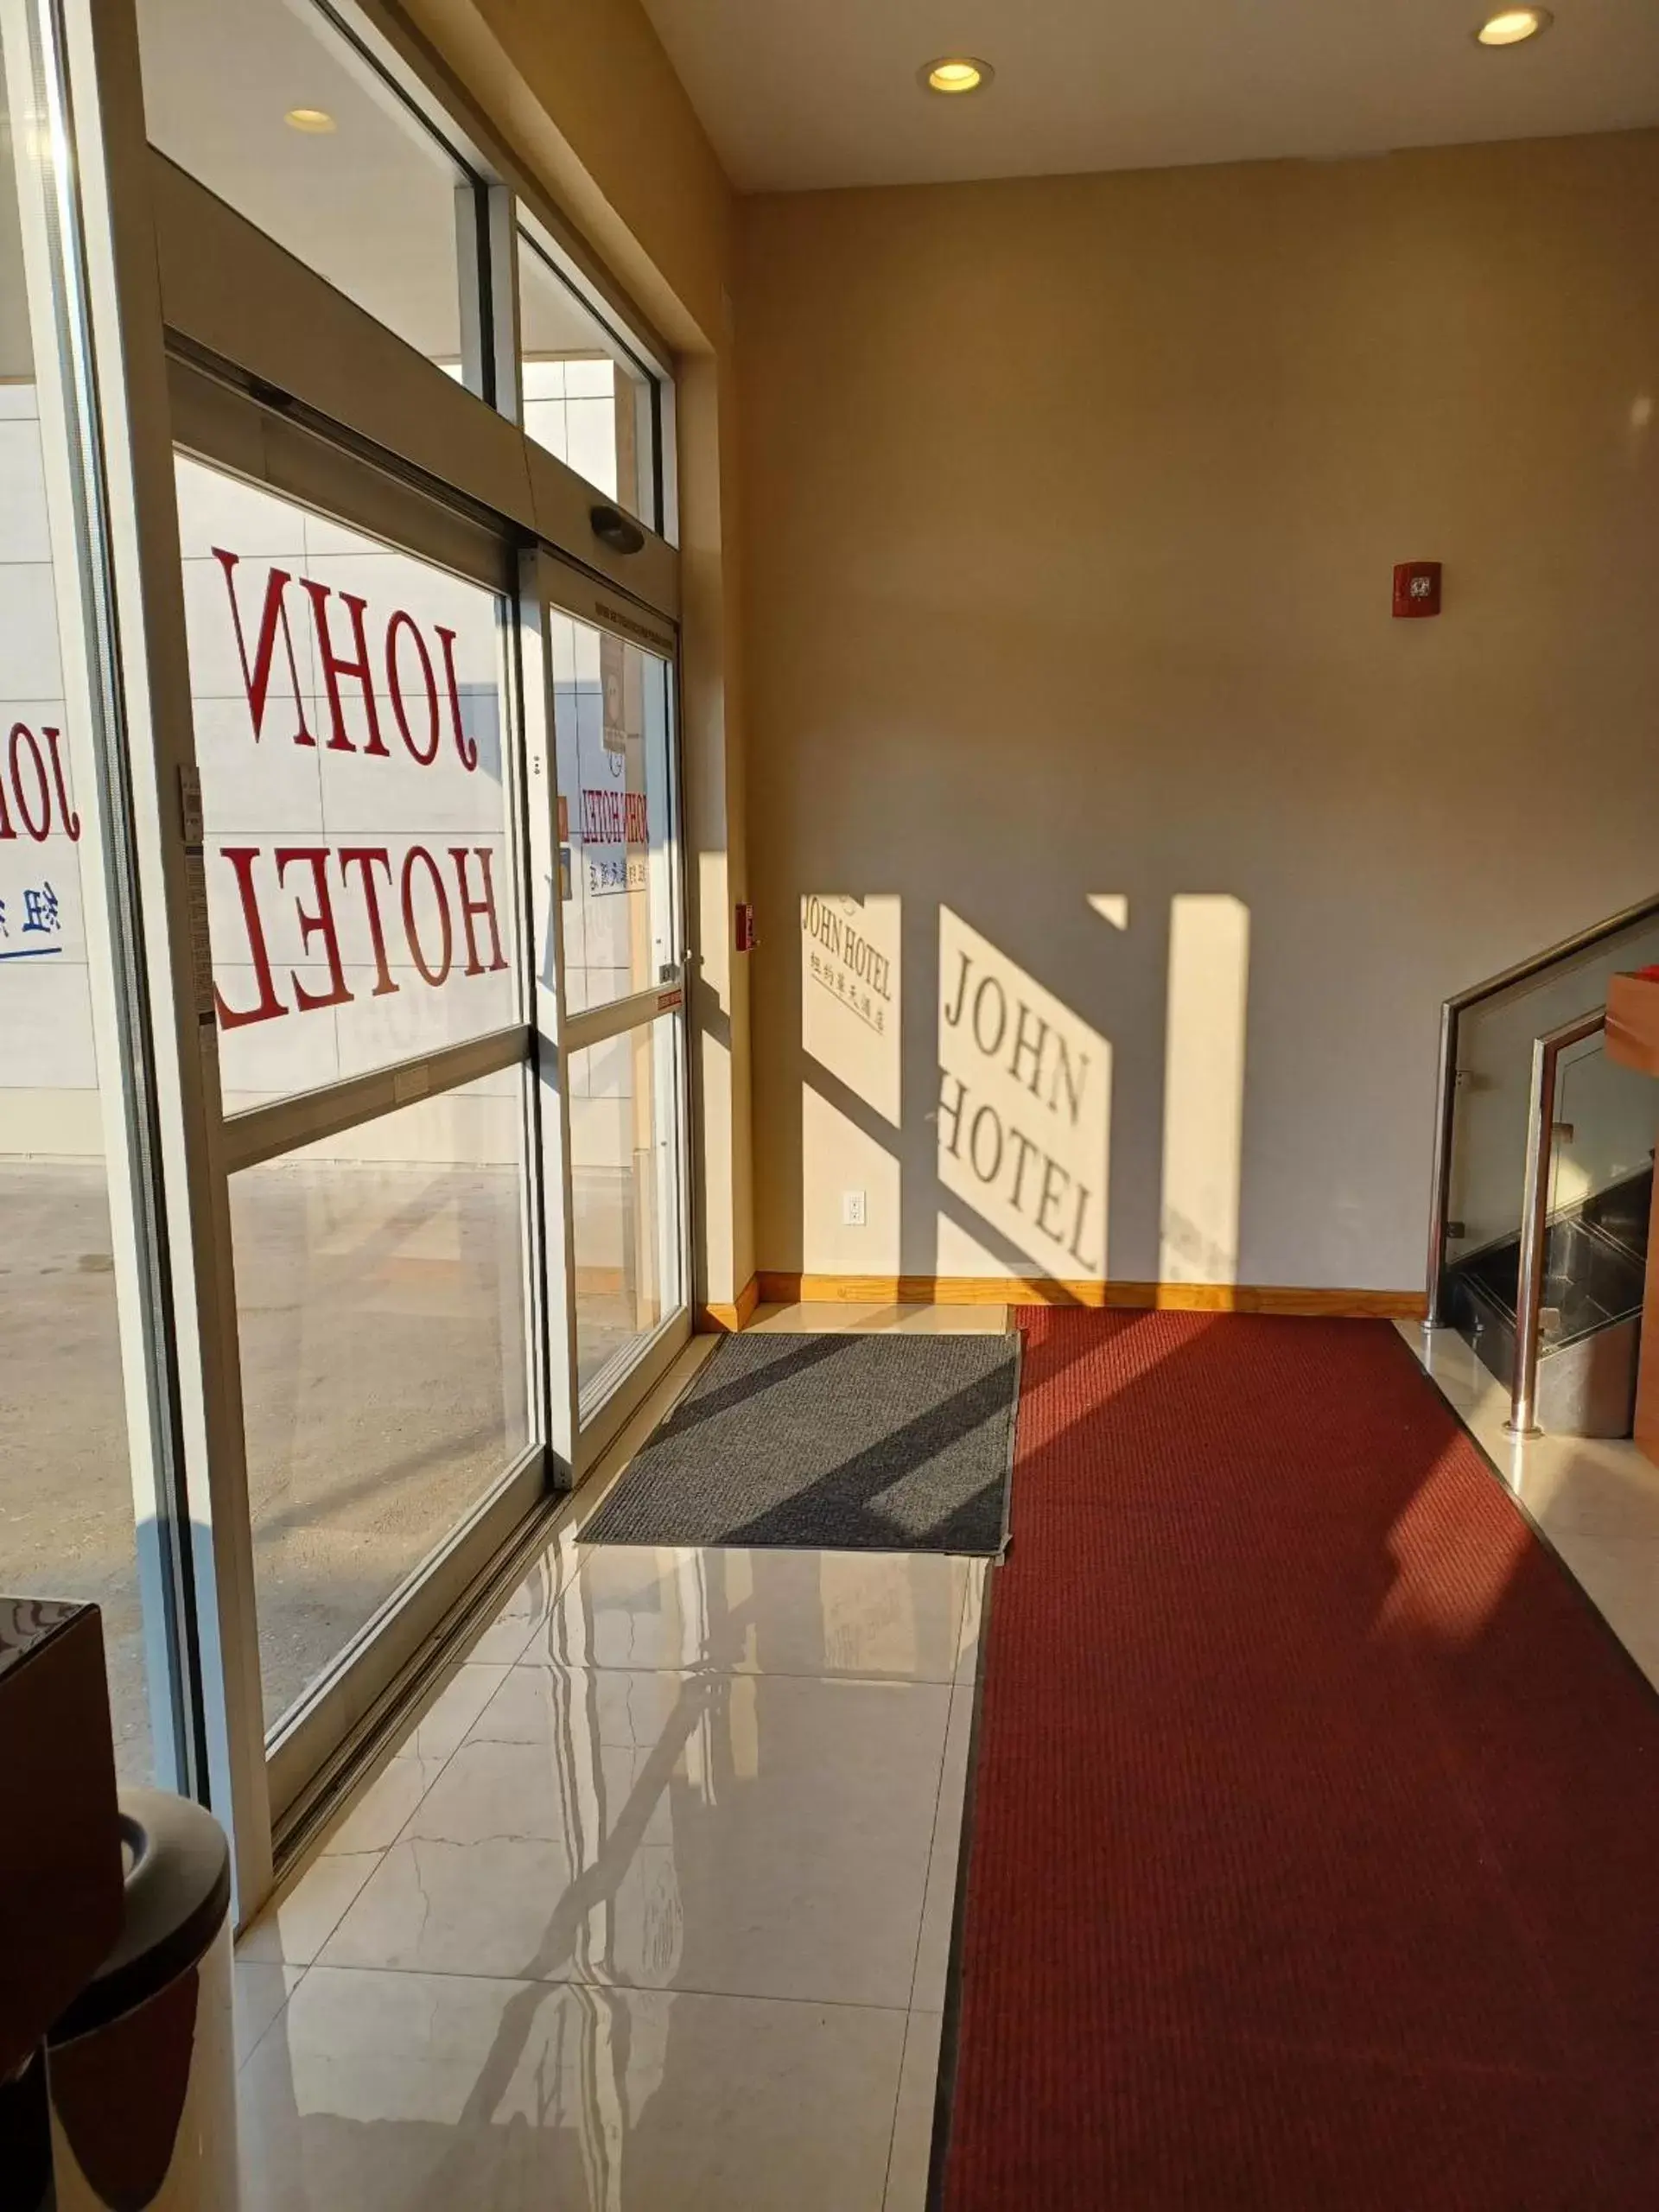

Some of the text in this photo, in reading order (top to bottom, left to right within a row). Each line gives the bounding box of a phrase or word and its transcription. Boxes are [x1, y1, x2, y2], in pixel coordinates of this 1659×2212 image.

[803, 893, 842, 957] JOHN
[843, 925, 891, 1001] HOTEL
[944, 949, 1090, 1128] JOHN
[938, 1068, 1097, 1274] HOTEL
